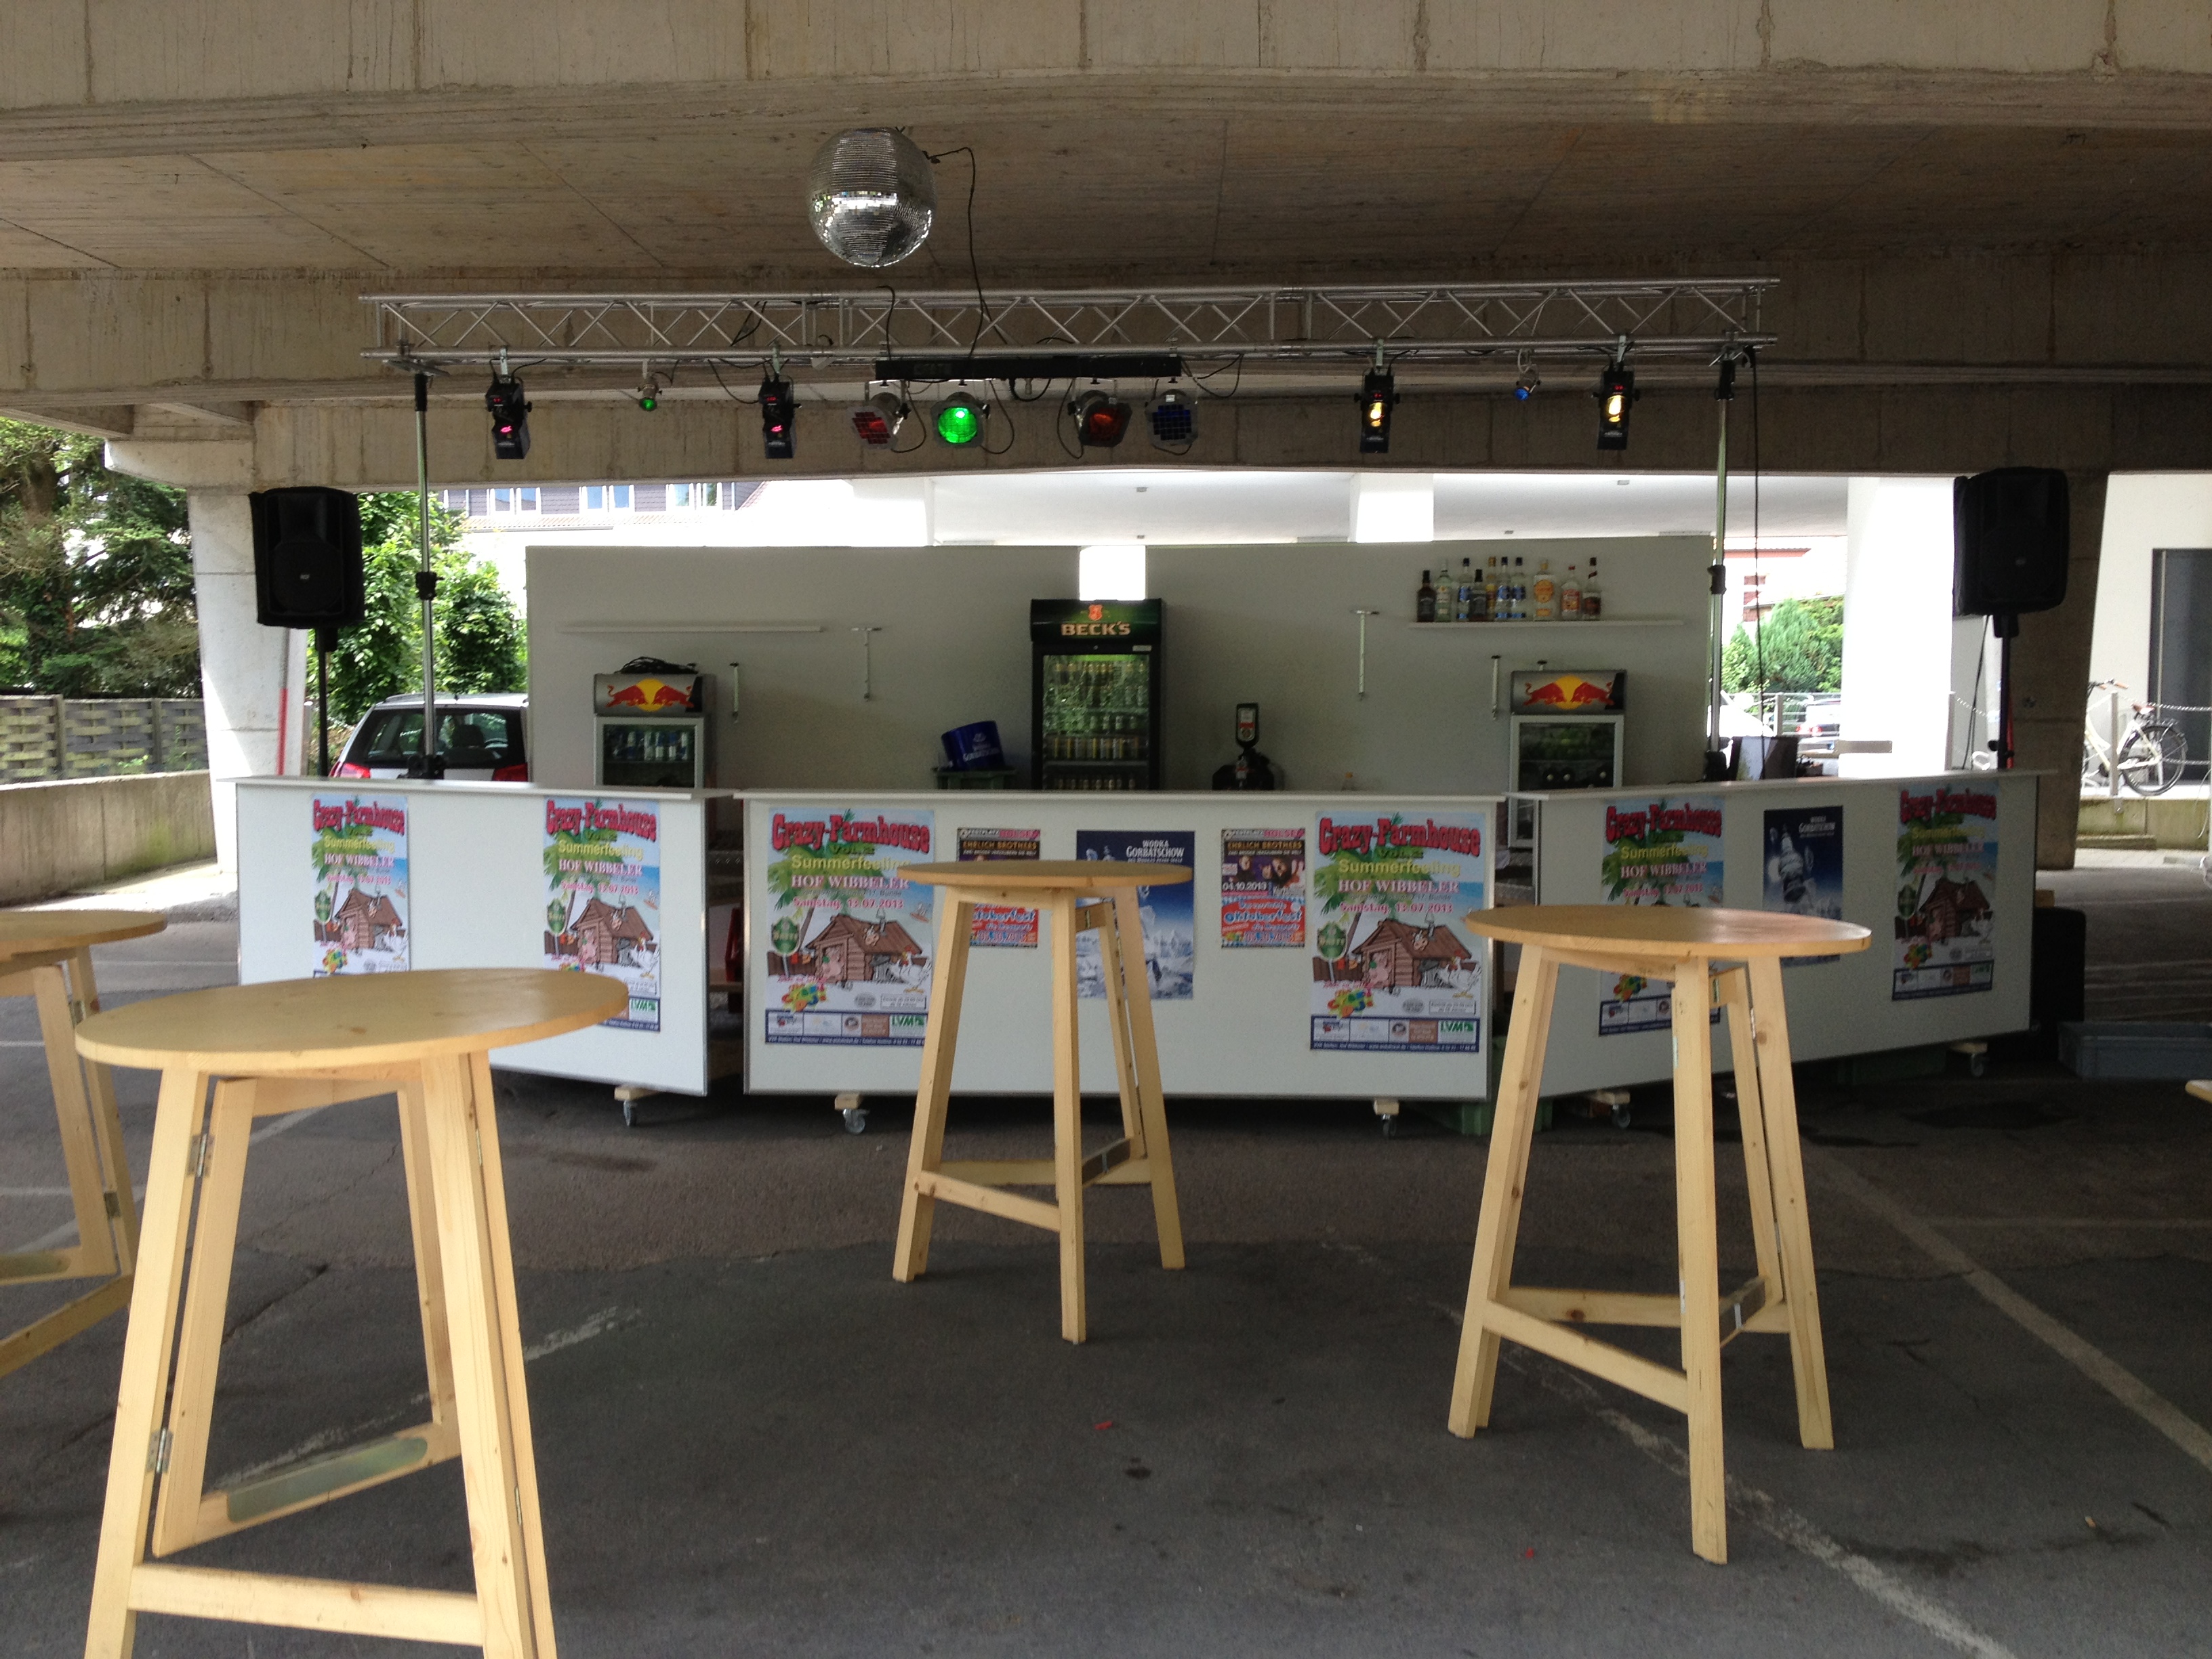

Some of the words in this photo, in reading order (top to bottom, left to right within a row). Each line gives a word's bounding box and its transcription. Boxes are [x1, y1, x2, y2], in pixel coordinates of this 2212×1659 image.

[1061, 621, 1131, 636] BECK'S
[546, 800, 657, 842] Crazy-Farmhouse
[1606, 802, 1723, 843] Crazy-Farmhouse
[772, 813, 930, 853] Crazy-Farmhouse
[1319, 817, 1481, 857] Crazy-Farmhouse
[325, 835, 394, 853] Summerfeeling
[558, 840, 642, 861] Summerfeeling
[963, 841, 995, 850] EHRLICH
[997, 841, 1037, 850] BROTHERS
[1126, 846, 1185, 858] GORBATSCHOW
[1228, 841, 1260, 850] EHRLICH
[1262, 841, 1302, 850] BROTHERS
[1620, 842, 1708, 859] Summerfeeling
[325, 853, 344, 864] HOF
[346, 854, 394, 867] WIBBELER
[559, 859, 581, 872] HOF
[584, 860, 642, 876] WIBBELER
[1338, 859, 1461, 878] Summerfeeling
[1621, 865, 1647, 879] HOF
[1650, 861, 1707, 877] WIBBELER
[791, 875, 825, 888] HOF
[828, 875, 910, 889] WIBBELER
[1223, 882, 1267, 890] 04.10.2013
[1338, 880, 1372, 893] HOF
[1376, 880, 1459, 895] WIBBELER
